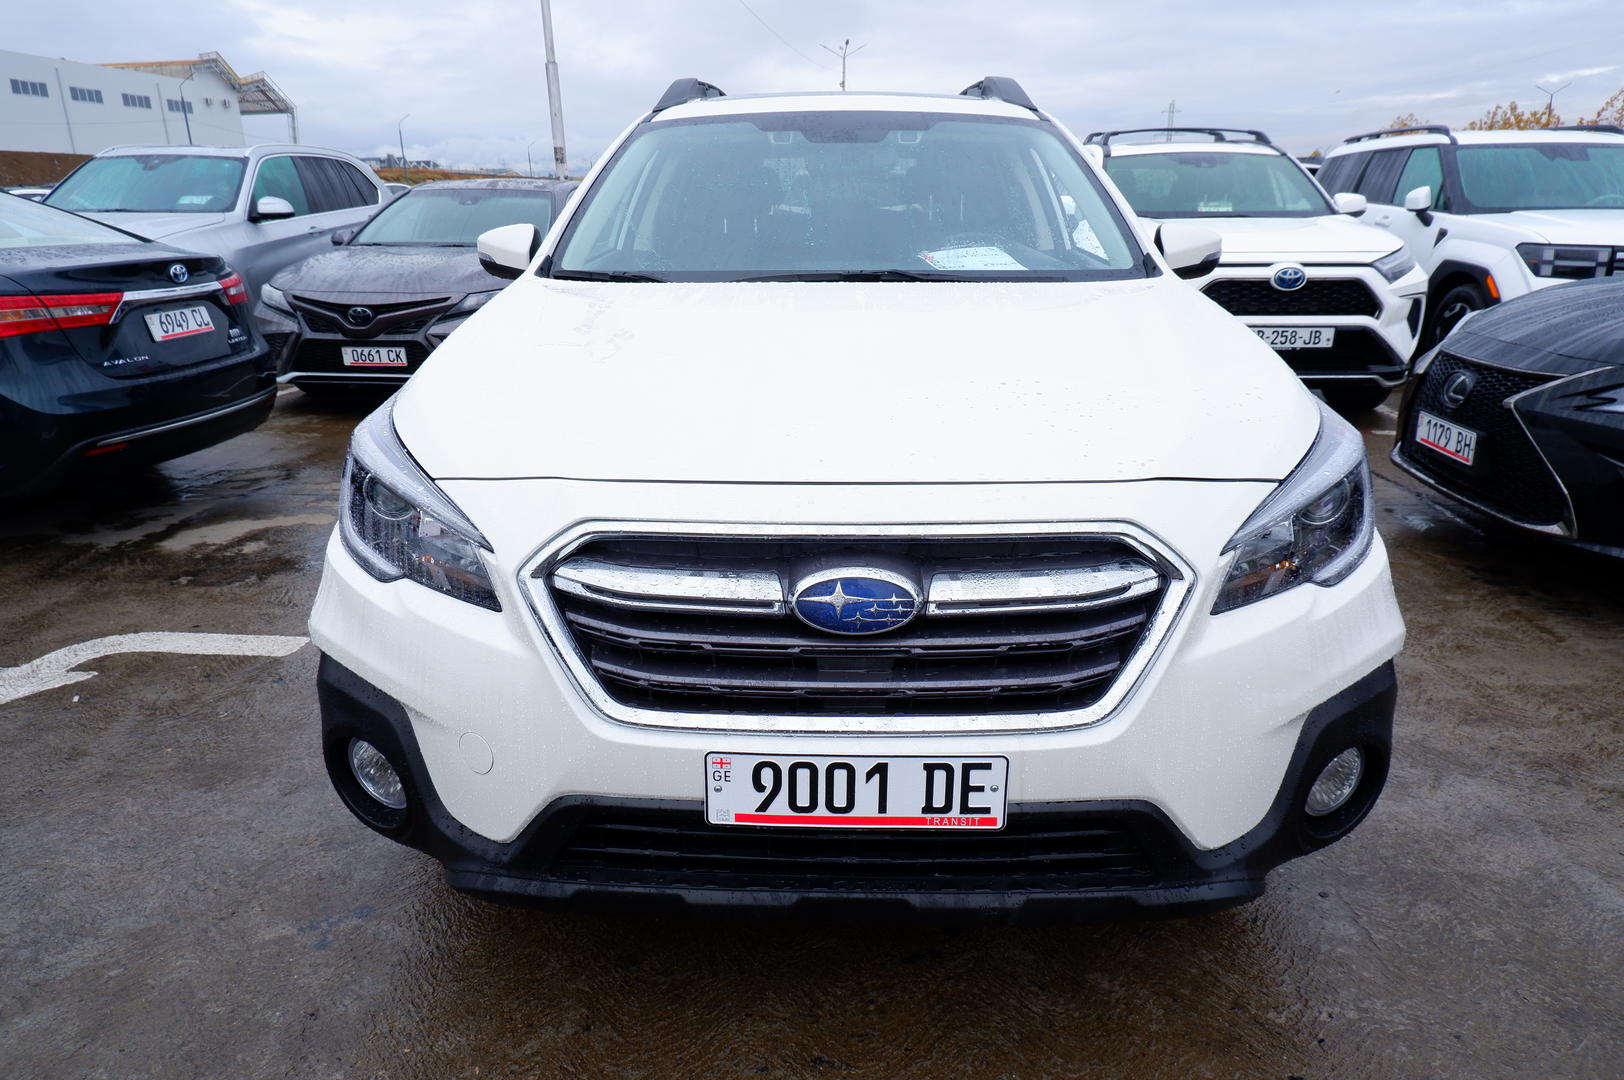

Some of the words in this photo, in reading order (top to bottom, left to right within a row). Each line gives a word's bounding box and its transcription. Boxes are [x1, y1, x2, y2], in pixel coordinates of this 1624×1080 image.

[160, 311, 190, 334] 6949
[191, 307, 210, 328] CL
[1252, 329, 1323, 345] B-258-JB
[351, 349, 382, 363] 0661
[387, 349, 404, 363] CK
[1426, 419, 1452, 448] 1179
[1455, 431, 1473, 458] BH
[712, 770, 732, 782] GE
[751, 760, 889, 815] 9001
[921, 762, 993, 815] DE
[925, 817, 981, 827] TRANSIT
